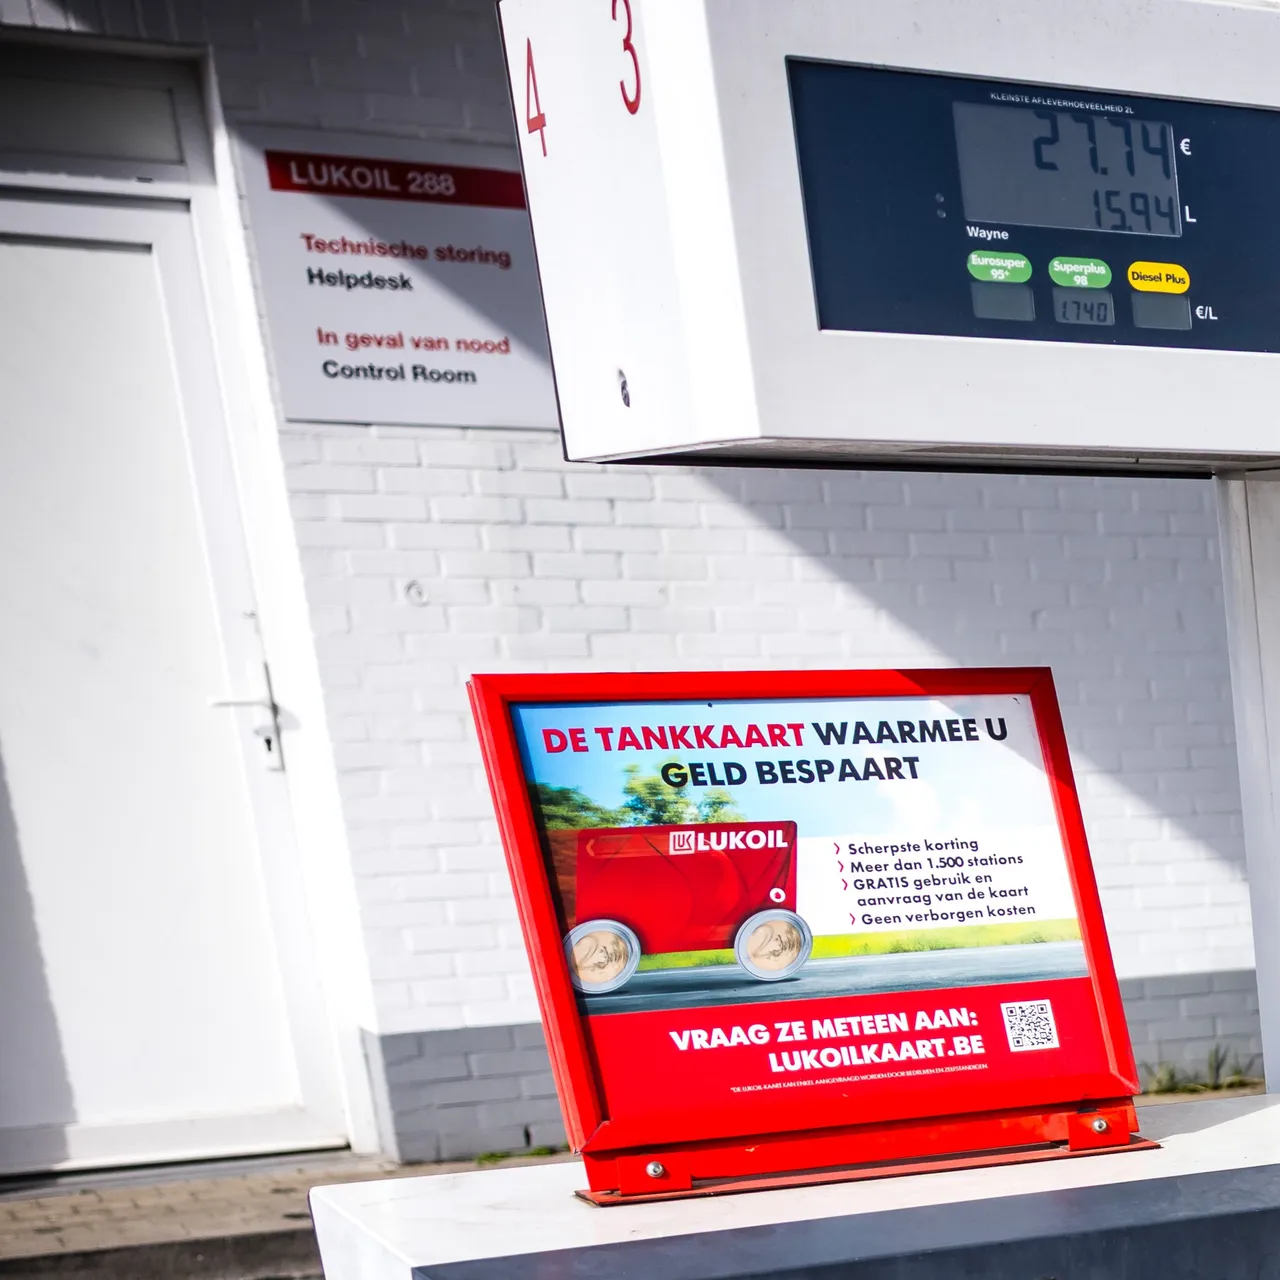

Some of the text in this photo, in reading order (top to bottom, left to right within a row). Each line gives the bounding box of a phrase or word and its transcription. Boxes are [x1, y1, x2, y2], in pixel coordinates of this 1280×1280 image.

[612, 0, 641, 115] 3
[526, 37, 547, 157] 4
[990, 92, 1135, 115] KLEINSTE AFLEVERHOEVEELHEID 2L
[1033, 110, 1192, 180] 27.74 €
[290, 161, 457, 195] LUKOIL 288
[1093, 189, 1197, 235] 15.94 L
[966, 226, 1009, 241] Wayne
[301, 233, 512, 269] Technische storing
[971, 254, 1026, 270] Eurosuper
[307, 267, 413, 291] Helpdesk
[1053, 260, 1106, 276] Superplus
[1131, 271, 1186, 285] Diesel Plus
[1073, 275, 1088, 286] 98
[1195, 305, 1218, 321] €/L
[316, 327, 510, 354] In geval van nood
[322, 360, 477, 384] Control Room
[542, 718, 1008, 753] DE TANKKAART WAARMEE U
[660, 756, 920, 788] GELD BESPAART
[697, 829, 788, 851] LUKOIL
[848, 838, 979, 856] Scherpste korting
[850, 854, 1024, 873] Meer dan 1.500 stations
[853, 872, 993, 891] GRATIS gebruik en
[857, 886, 1029, 907] aanvraag van de kaart
[861, 904, 1036, 925] Geen verborgen kosten
[669, 1007, 978, 1051] VRAAG ZE METEEN AAN:
[768, 1034, 985, 1073] LUKOILKAART.BE
